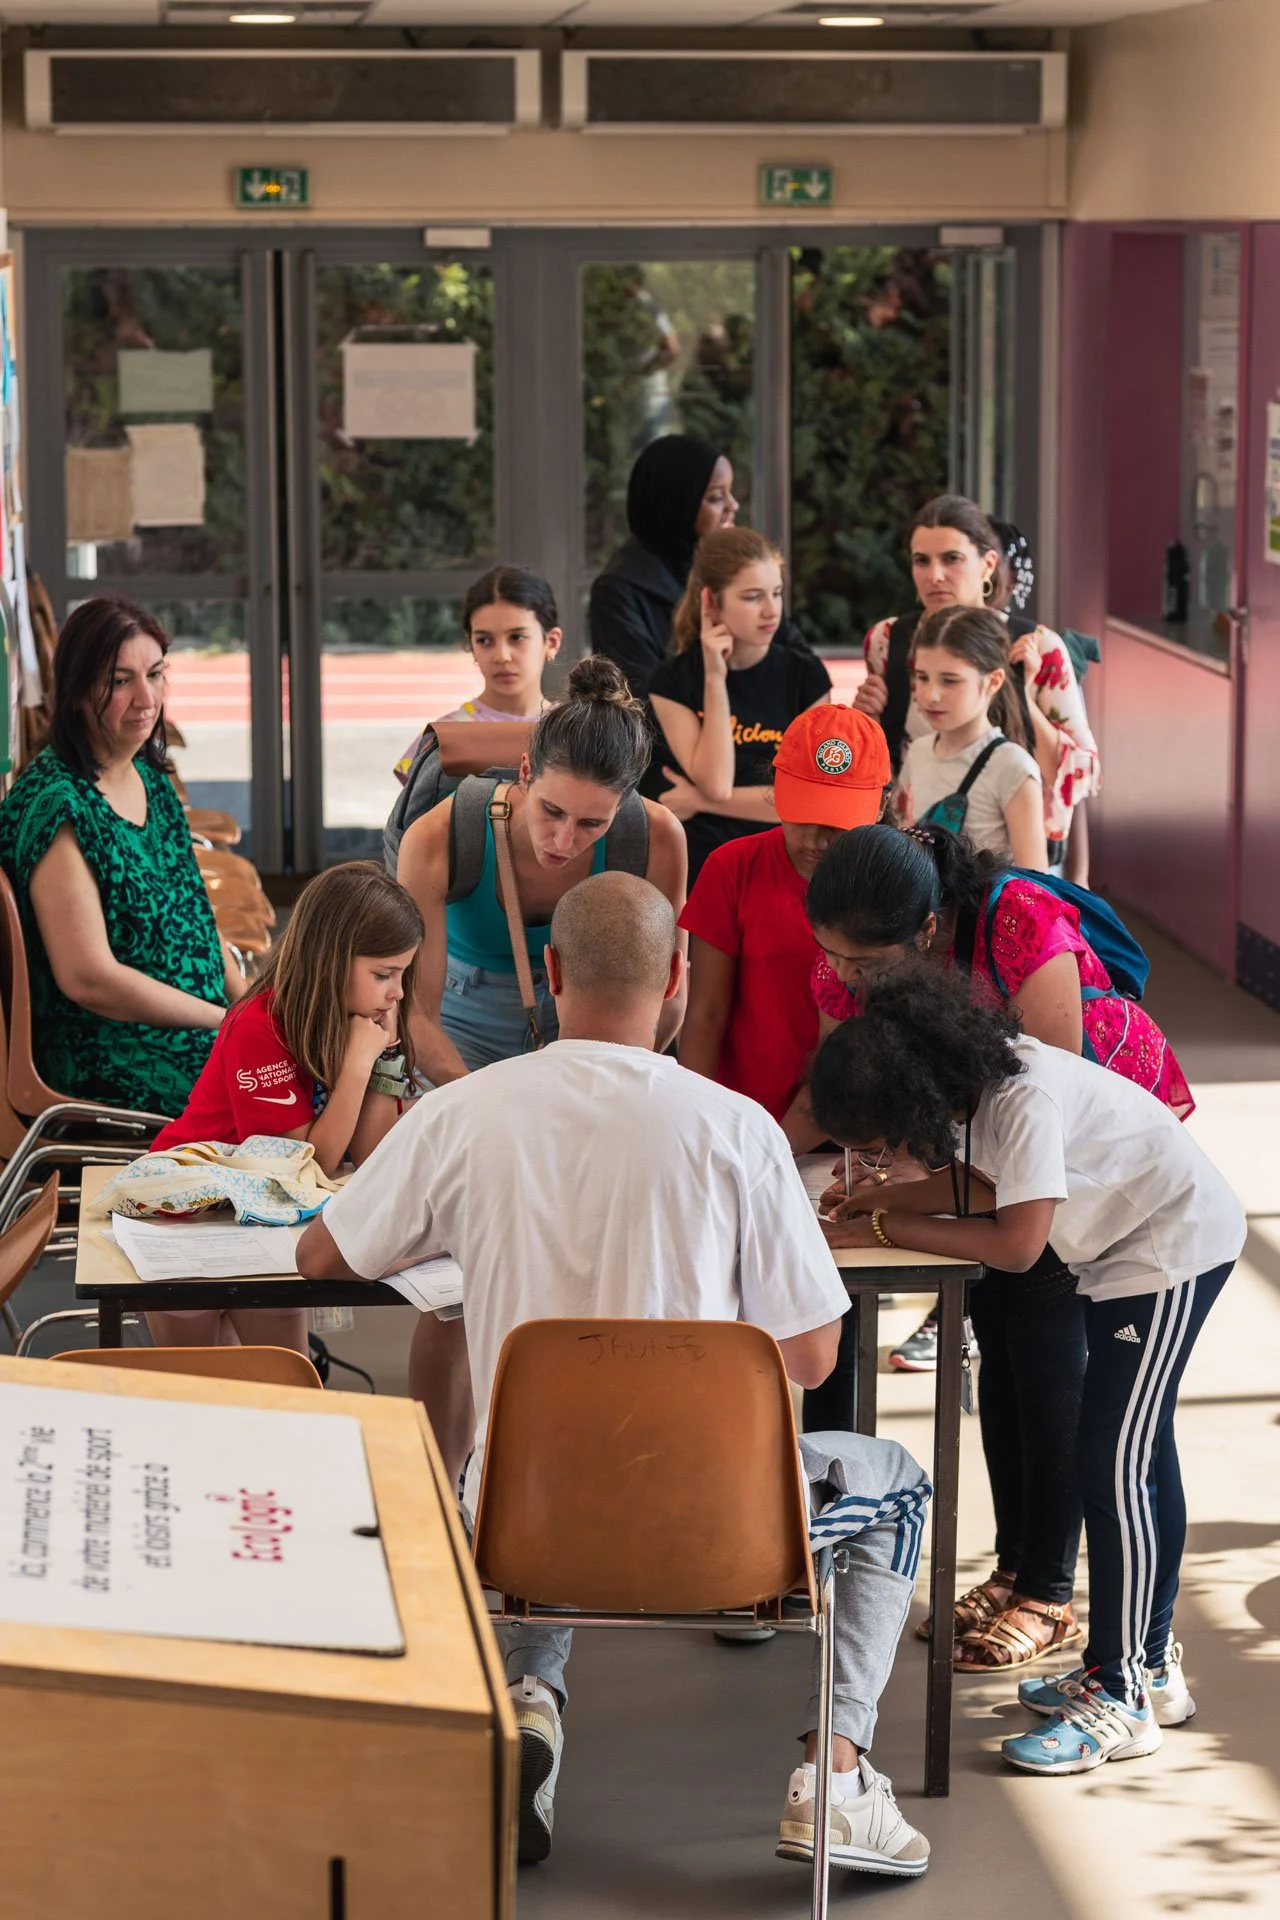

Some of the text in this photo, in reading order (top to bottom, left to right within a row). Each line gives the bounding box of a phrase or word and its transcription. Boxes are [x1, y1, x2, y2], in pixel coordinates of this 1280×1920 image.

[820, 763, 845, 773] PARIS
[256, 1060, 288, 1074] AGENCE
[273, 1072, 297, 1086] SPORT
[1113, 1332, 1141, 1344] adidas
[20, 1426, 55, 1445] vie
[15, 1471, 53, 1484] la
[71, 1426, 122, 1593] de votre matériel de sport
[20, 1487, 51, 1559] commence
[133, 1514, 171, 1551] loisirs
[138, 1553, 172, 1569] et
